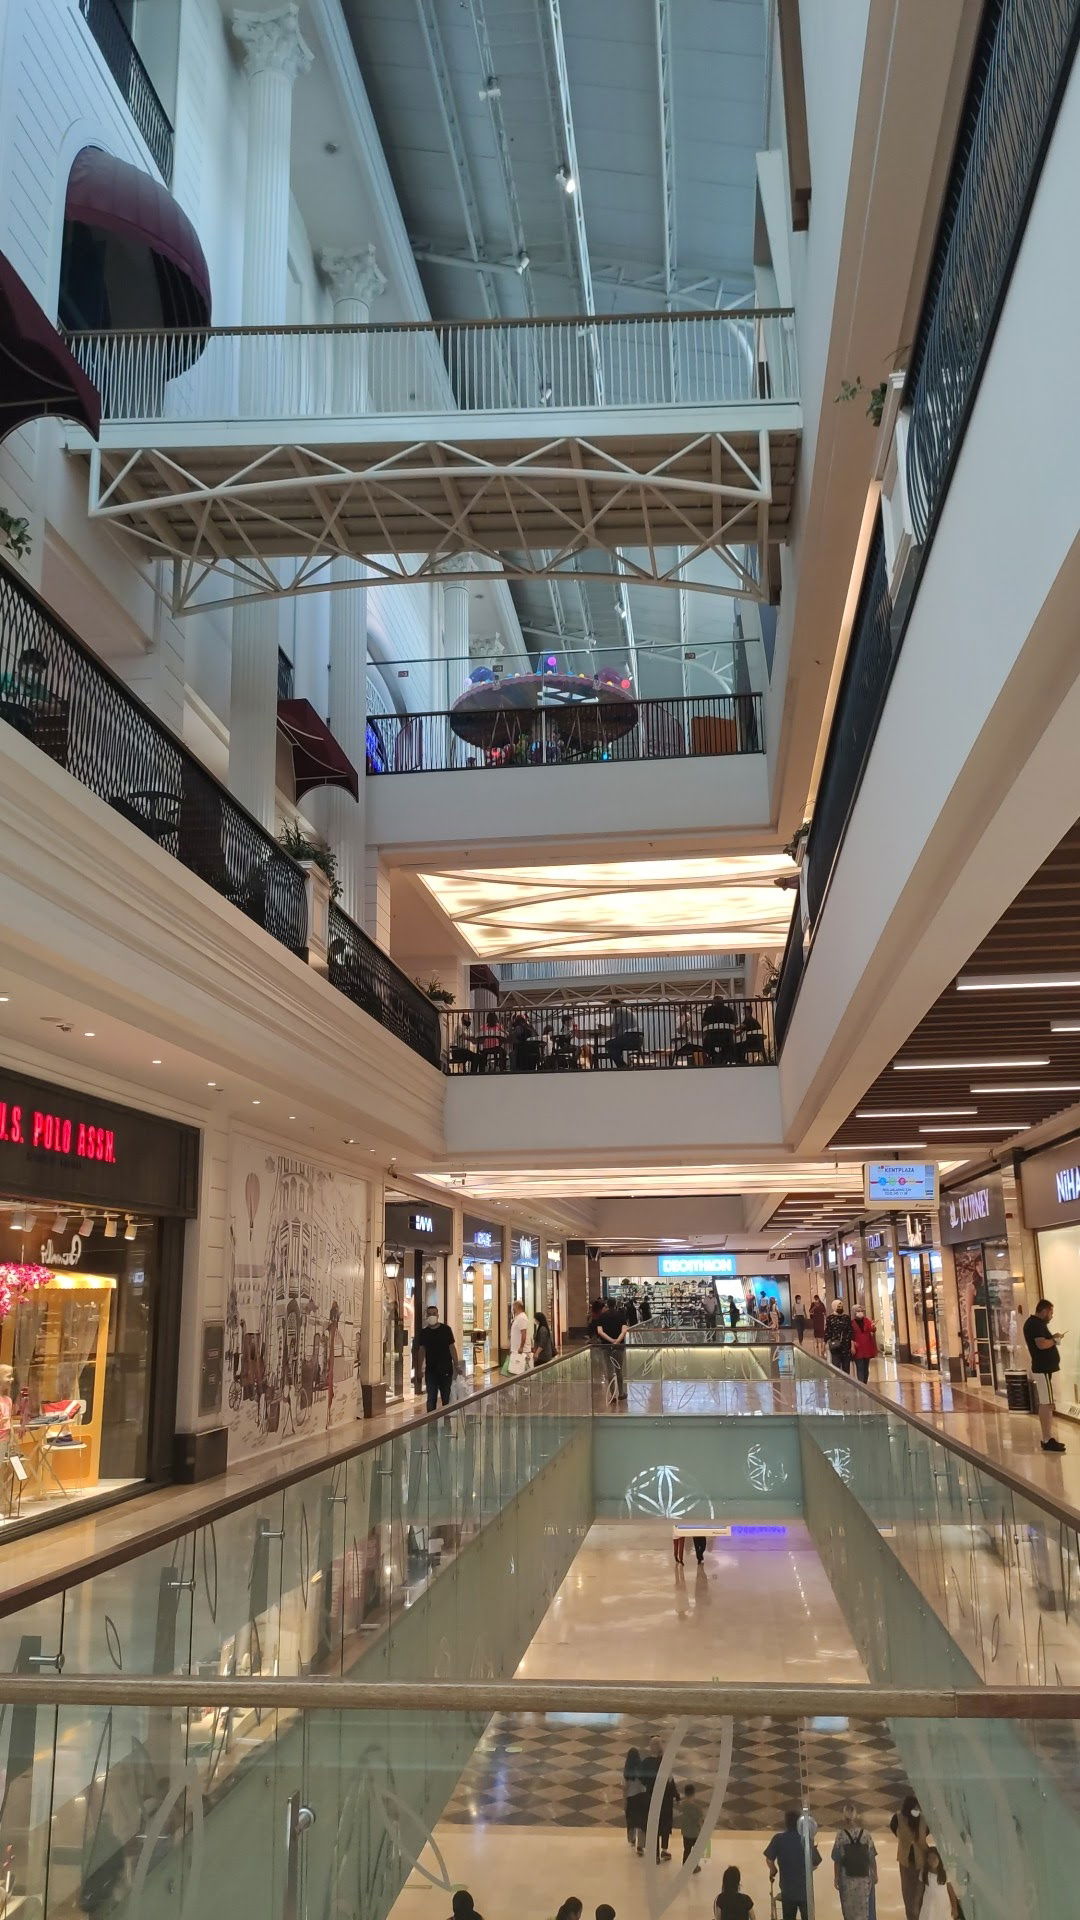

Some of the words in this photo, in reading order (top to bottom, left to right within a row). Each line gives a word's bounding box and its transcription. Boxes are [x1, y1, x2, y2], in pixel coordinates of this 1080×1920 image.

[33, 1111, 72, 1154] POLO
[959, 1188, 990, 1233] JOURNEY
[662, 1258, 733, 1273] DECATHLON
